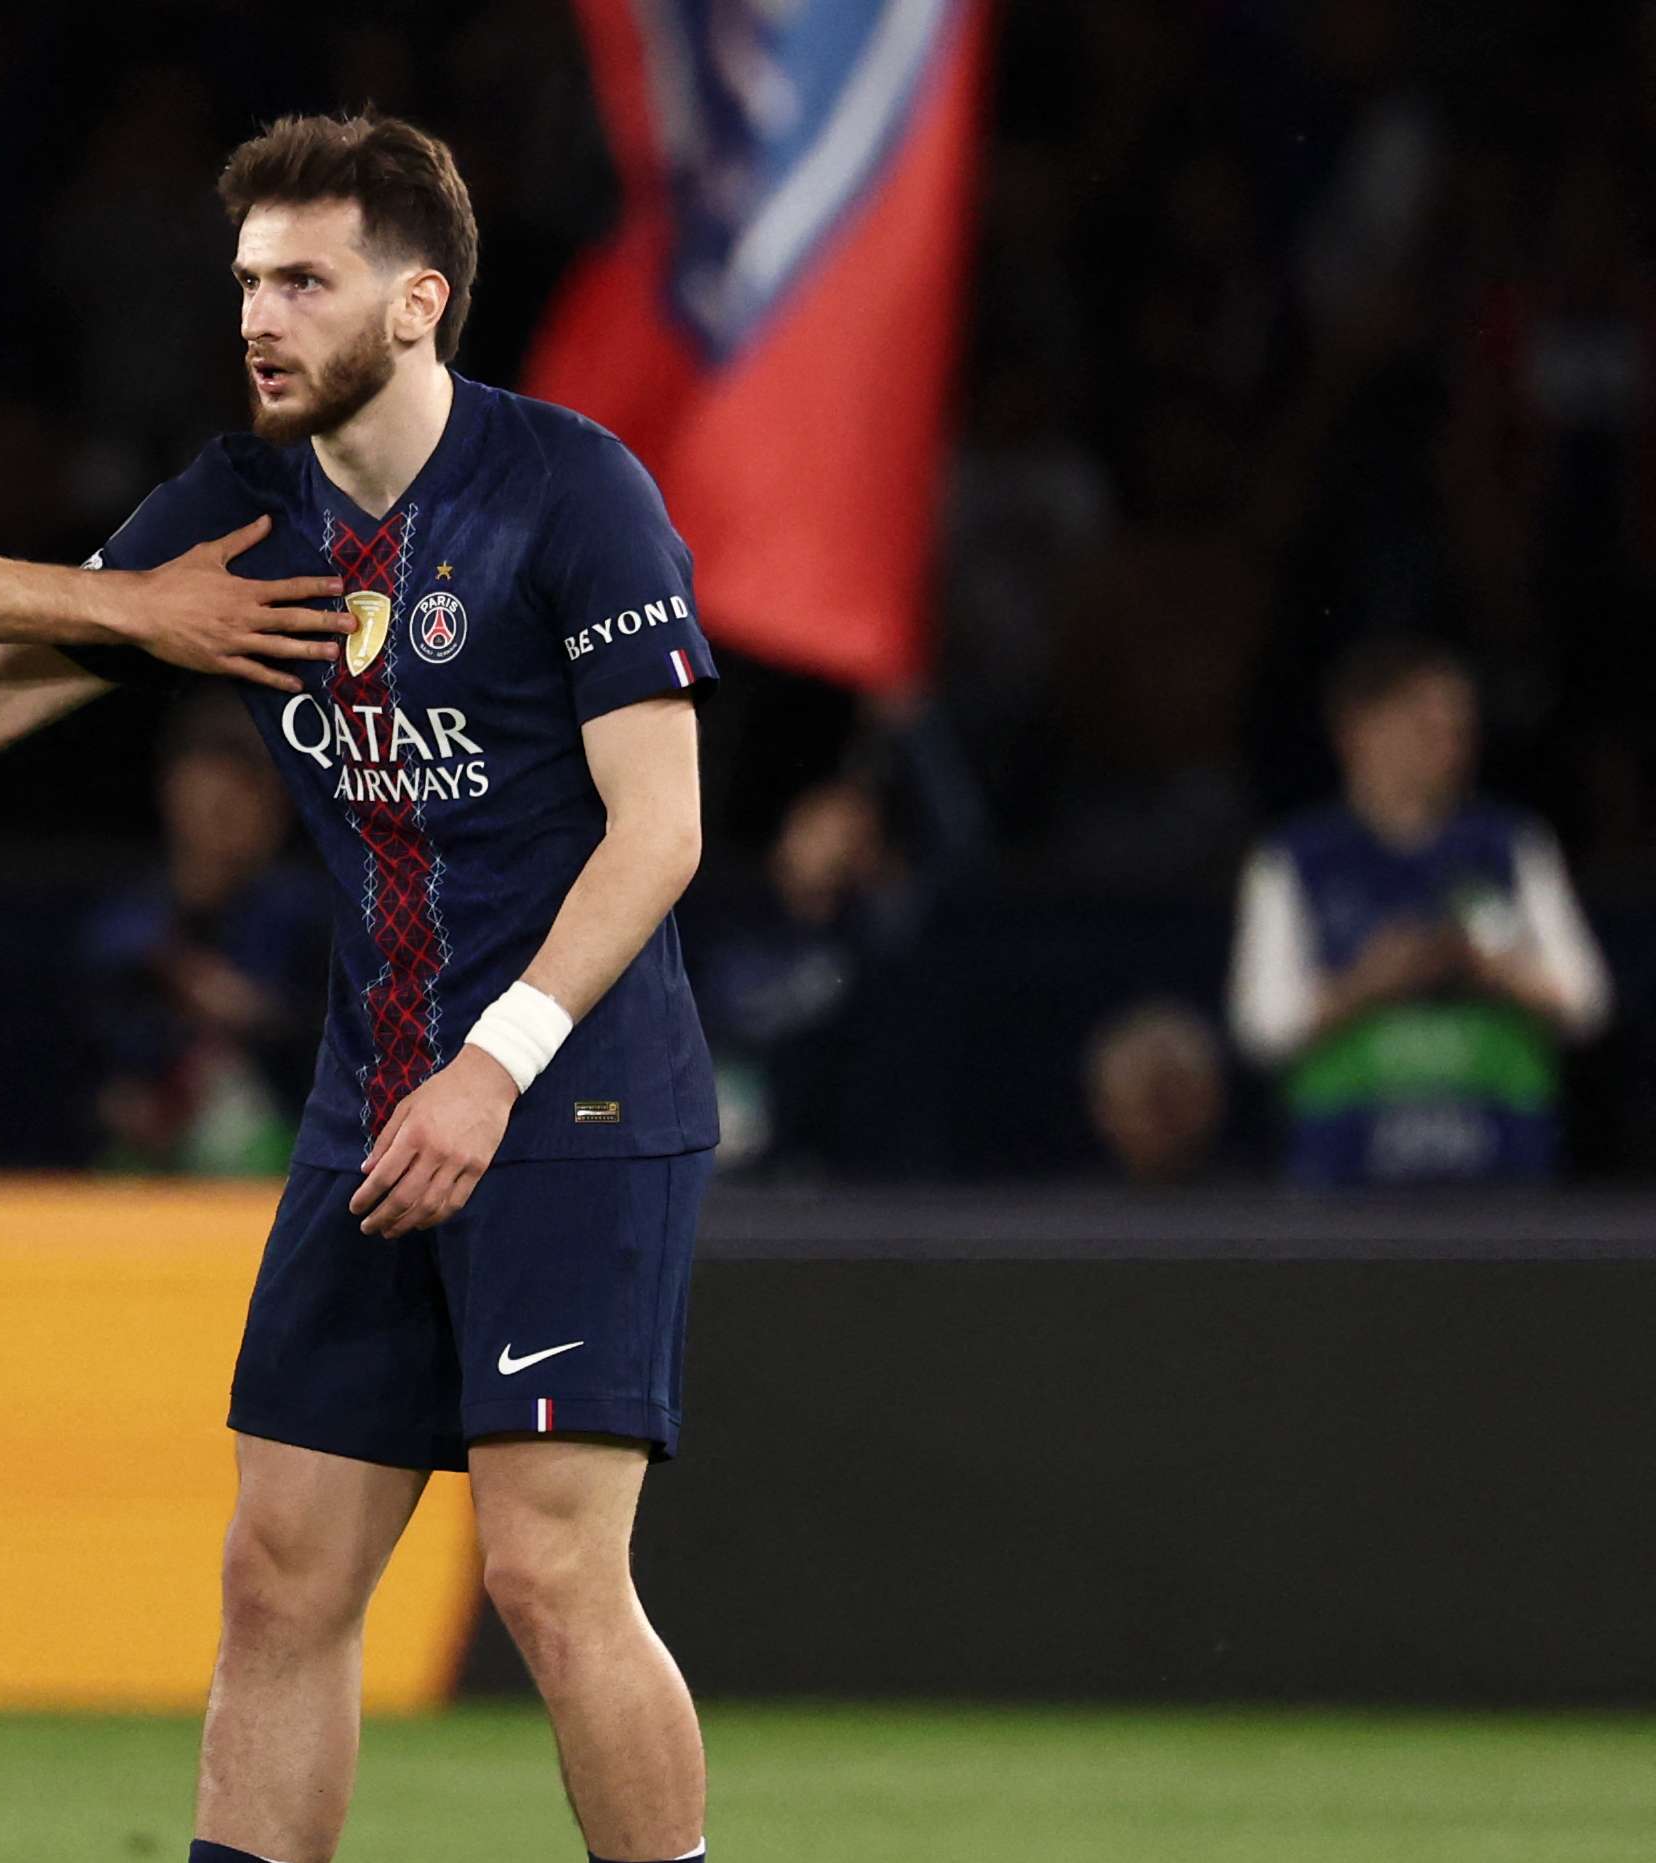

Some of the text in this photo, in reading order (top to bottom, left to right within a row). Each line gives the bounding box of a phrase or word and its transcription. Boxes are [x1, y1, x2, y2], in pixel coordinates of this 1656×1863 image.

[420, 595, 458, 613] PARIS
[564, 596, 689, 661] BEYOND
[281, 693, 484, 769] QATAR
[334, 761, 489, 802] AIRWAYS
